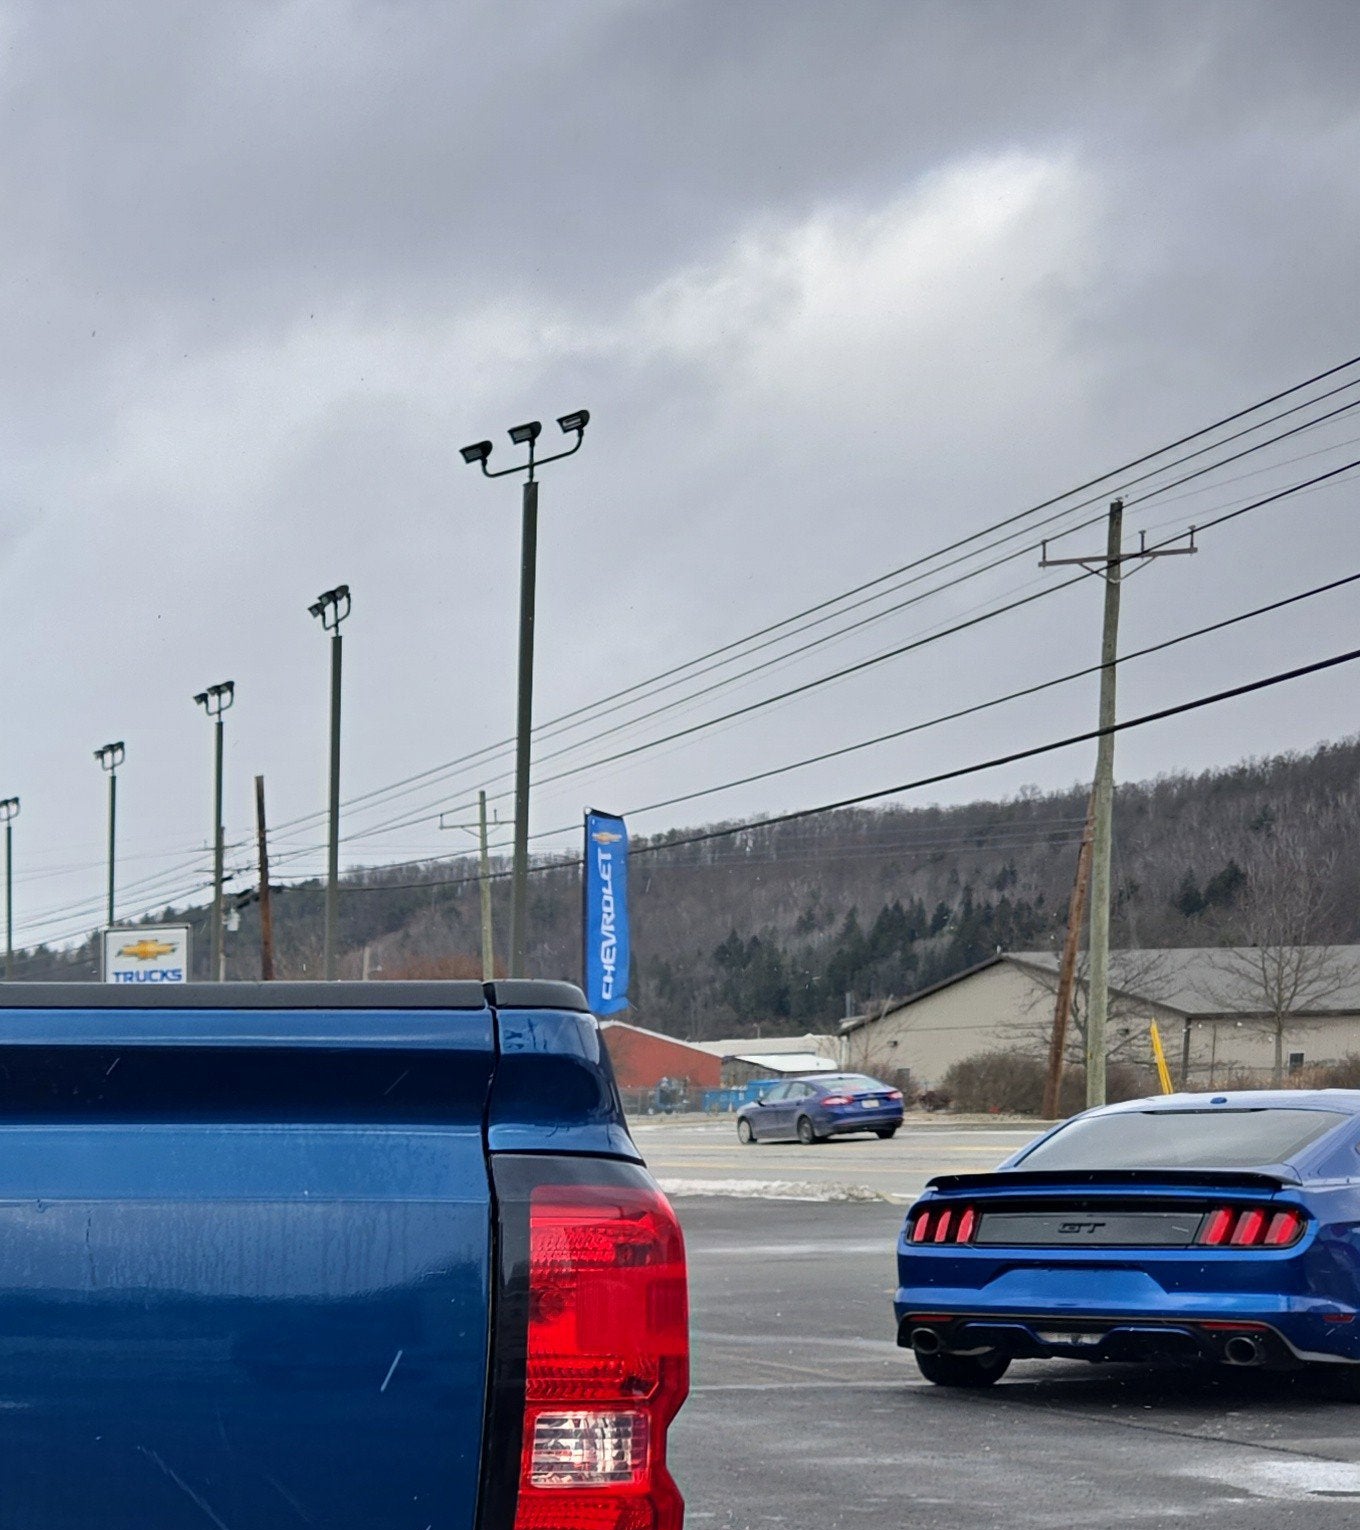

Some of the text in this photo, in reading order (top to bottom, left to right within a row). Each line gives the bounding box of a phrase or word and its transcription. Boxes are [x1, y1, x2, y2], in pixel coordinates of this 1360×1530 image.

[598, 846, 618, 1000] CHEVROLET
[113, 968, 183, 983] TRUCKS
[1058, 1222, 1106, 1233] GT
